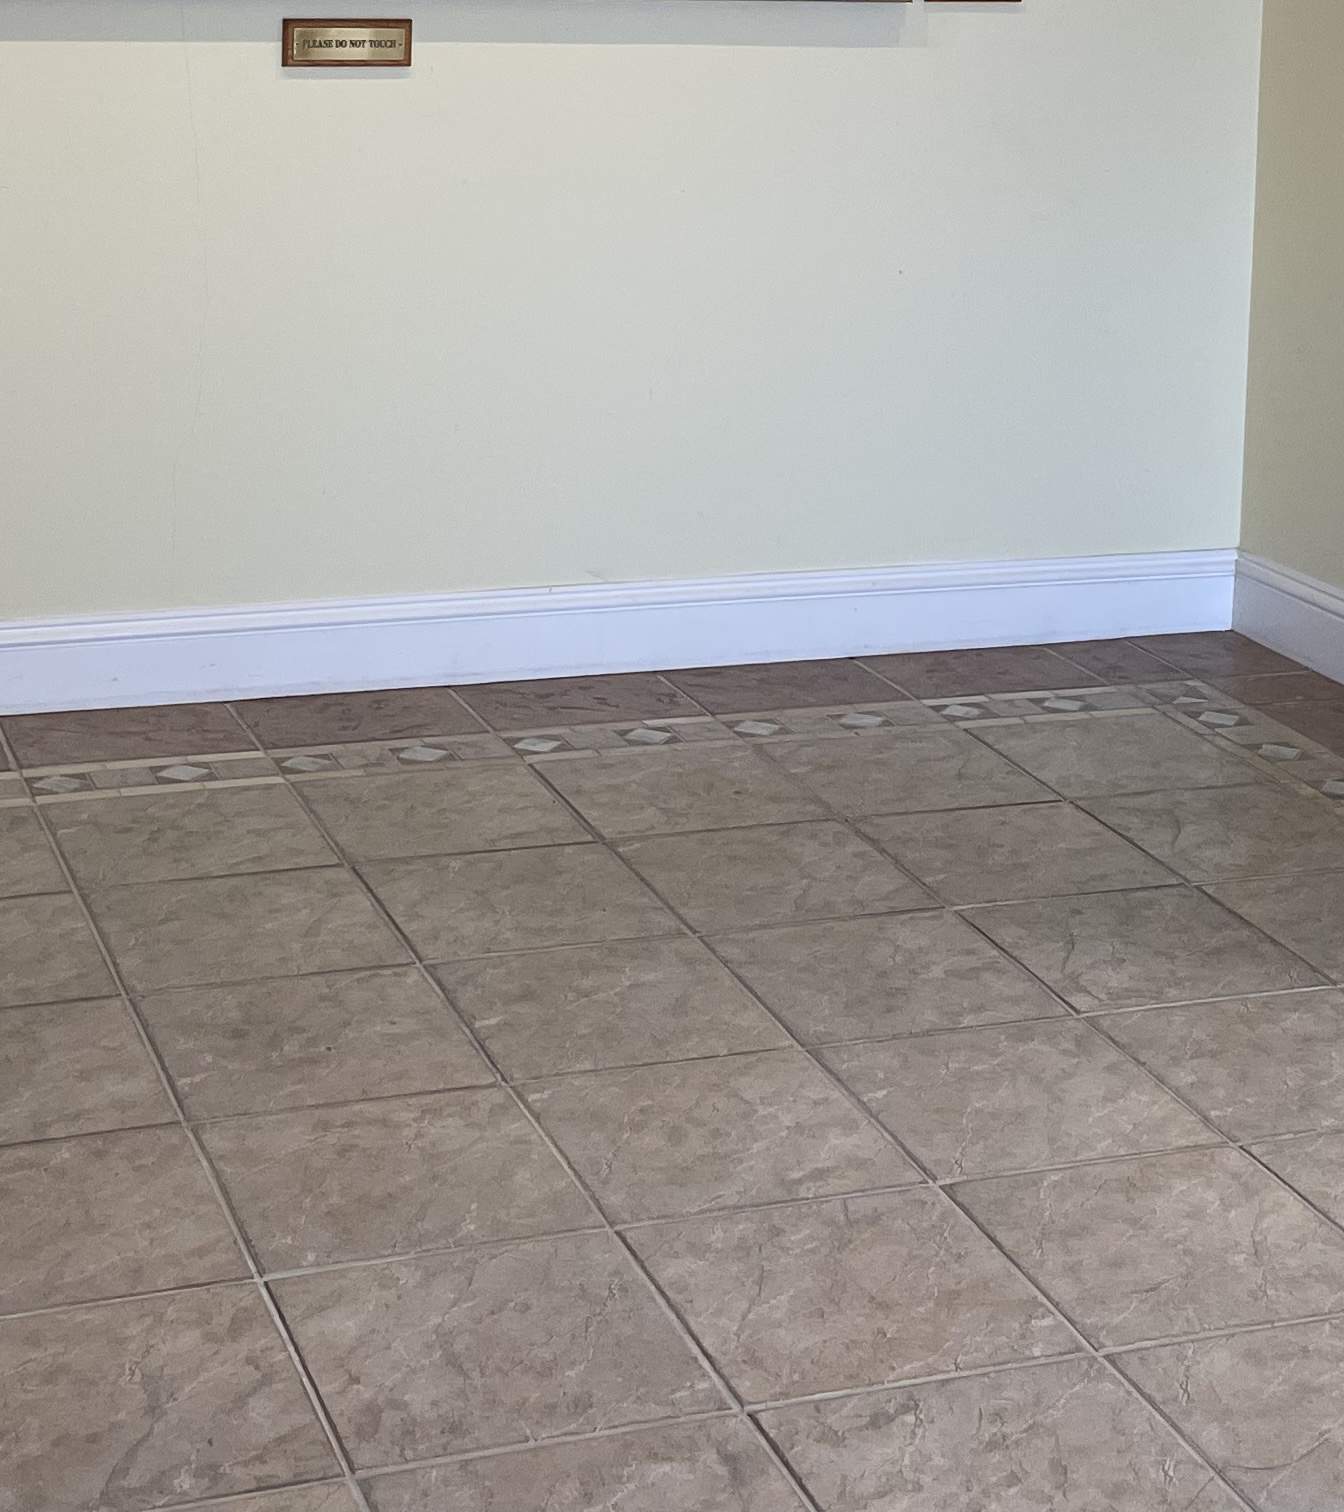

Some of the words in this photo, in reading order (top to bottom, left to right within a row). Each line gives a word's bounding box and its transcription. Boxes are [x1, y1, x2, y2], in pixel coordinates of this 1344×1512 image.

[302, 39, 333, 49] PLEASE
[335, 39, 347, 49] DO
[349, 39, 367, 49] NOT
[368, 39, 396, 49] TOUCH
